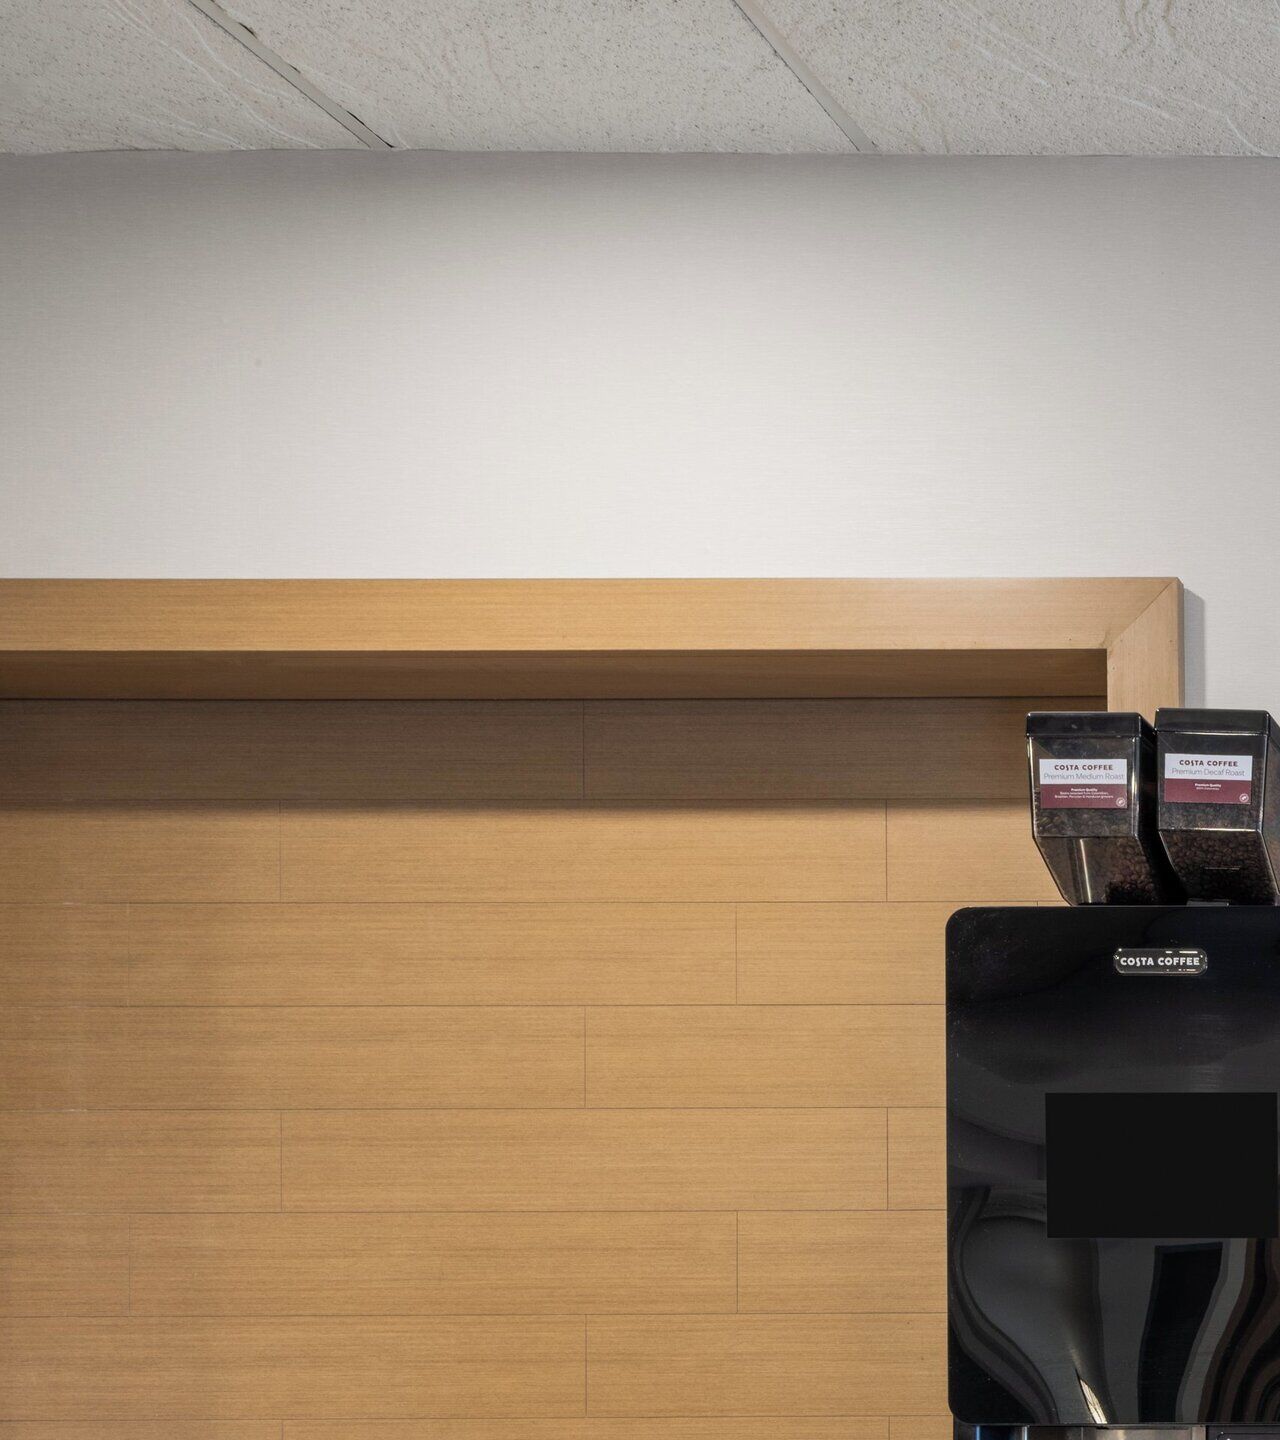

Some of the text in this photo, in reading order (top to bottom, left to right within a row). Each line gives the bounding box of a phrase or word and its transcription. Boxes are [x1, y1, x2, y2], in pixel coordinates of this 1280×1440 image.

[1172, 767, 1245, 777] Premium Decaf Roast
[1120, 957, 1200, 967] COSTA COFFEE
